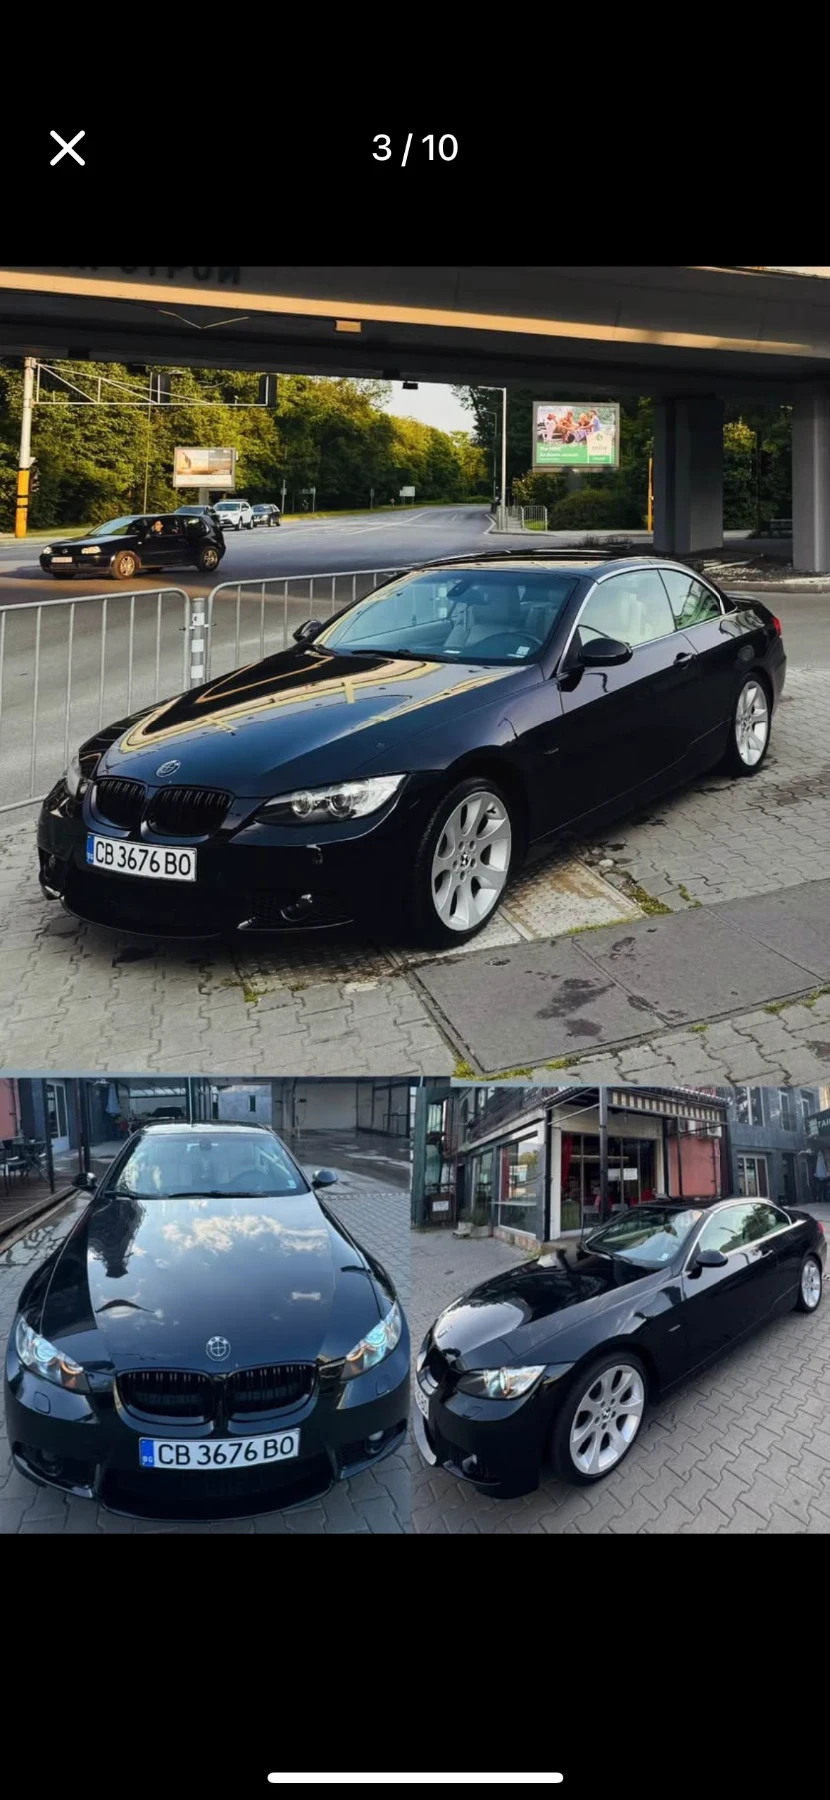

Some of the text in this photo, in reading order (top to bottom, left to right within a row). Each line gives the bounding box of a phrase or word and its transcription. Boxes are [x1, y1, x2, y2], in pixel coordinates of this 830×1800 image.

[95, 841, 114, 865] CB
[117, 846, 161, 872] 3676
[158, 1444, 191, 1465] CB
[196, 1441, 258, 1466] 3676
